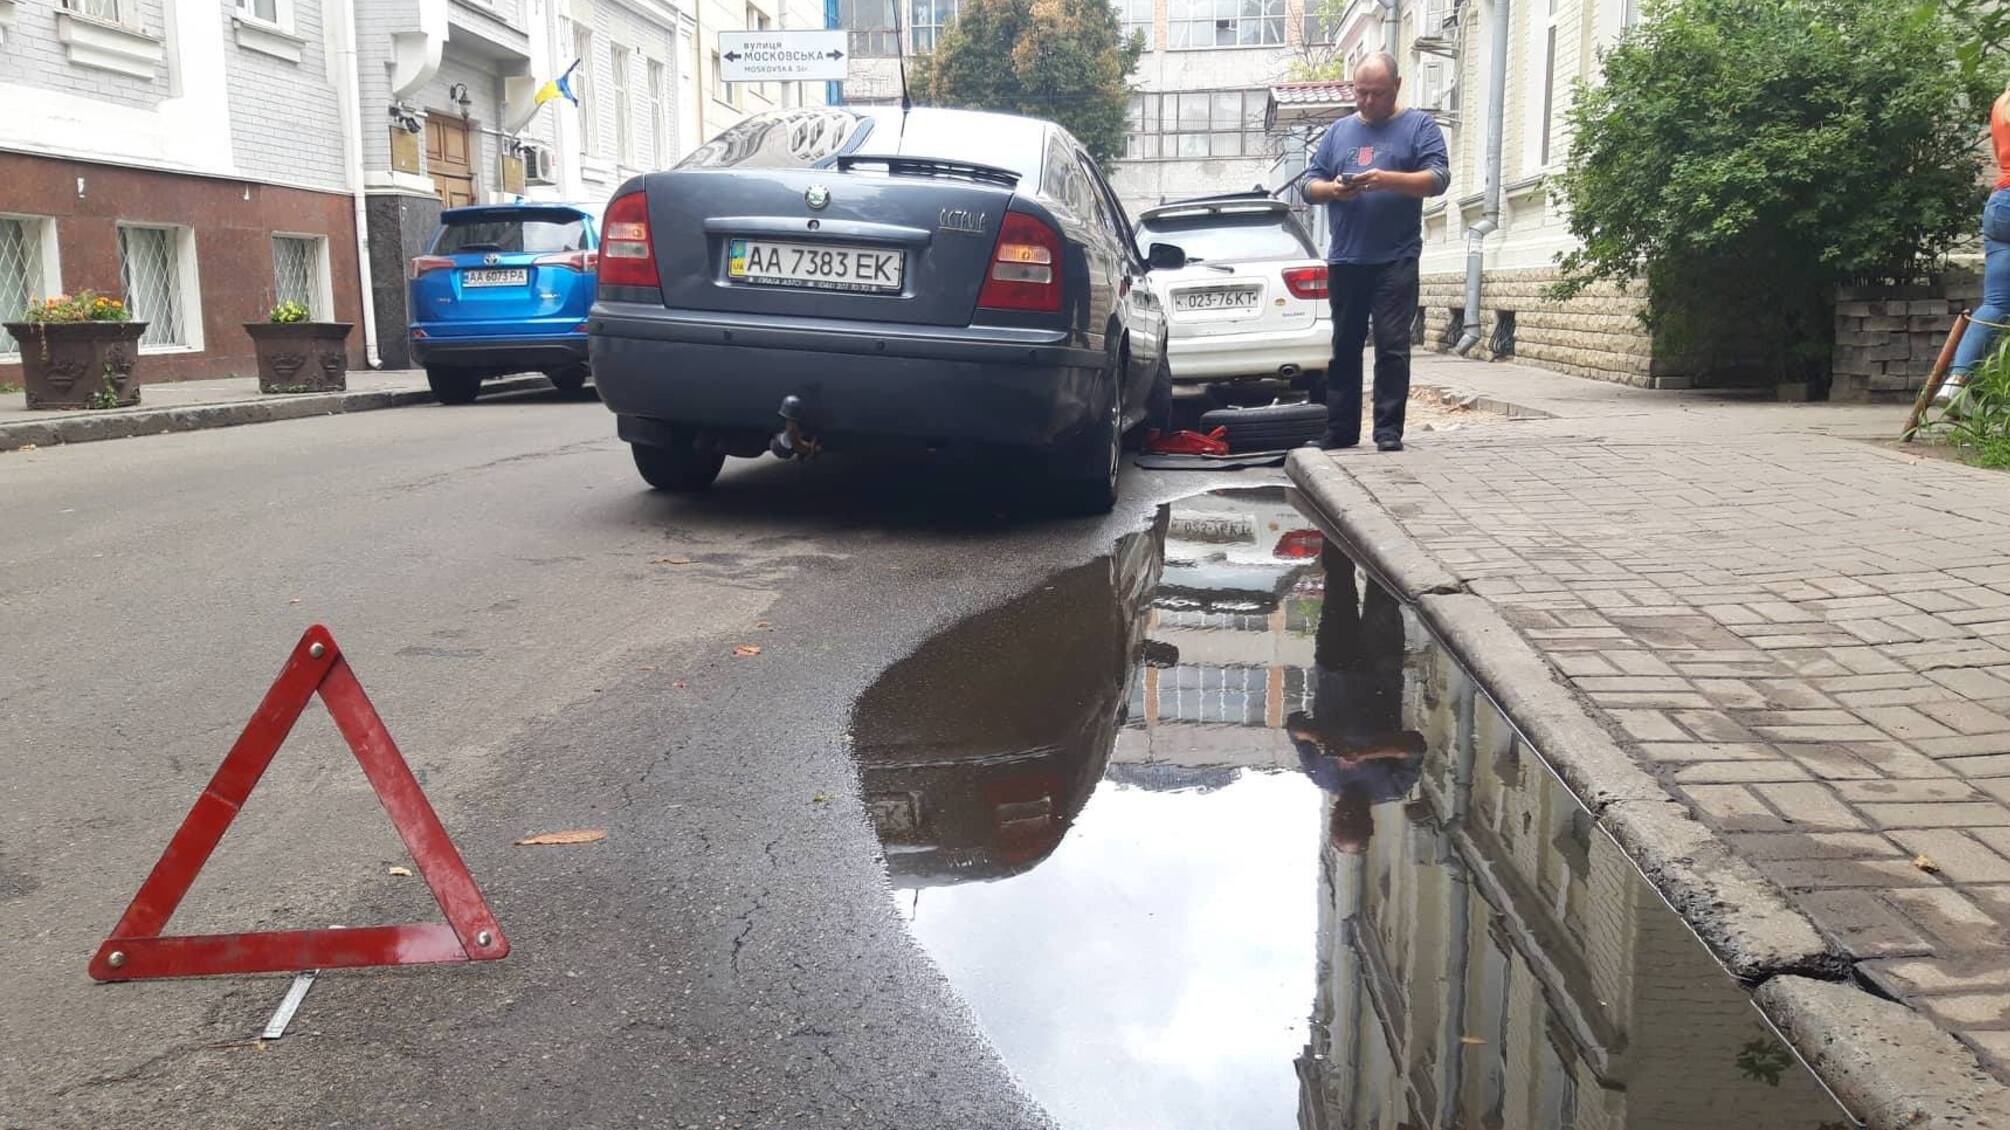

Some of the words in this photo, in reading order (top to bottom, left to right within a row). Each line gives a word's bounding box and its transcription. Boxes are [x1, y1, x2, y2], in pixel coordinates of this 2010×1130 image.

[744, 42, 782, 50] вулиця
[744, 51, 824, 62] МОСКОВСЬКА
[747, 246, 782, 274] AA
[790, 249, 849, 277] 7383
[856, 253, 893, 281] EK
[470, 270, 484, 281] AA
[510, 269, 525, 280] PA
